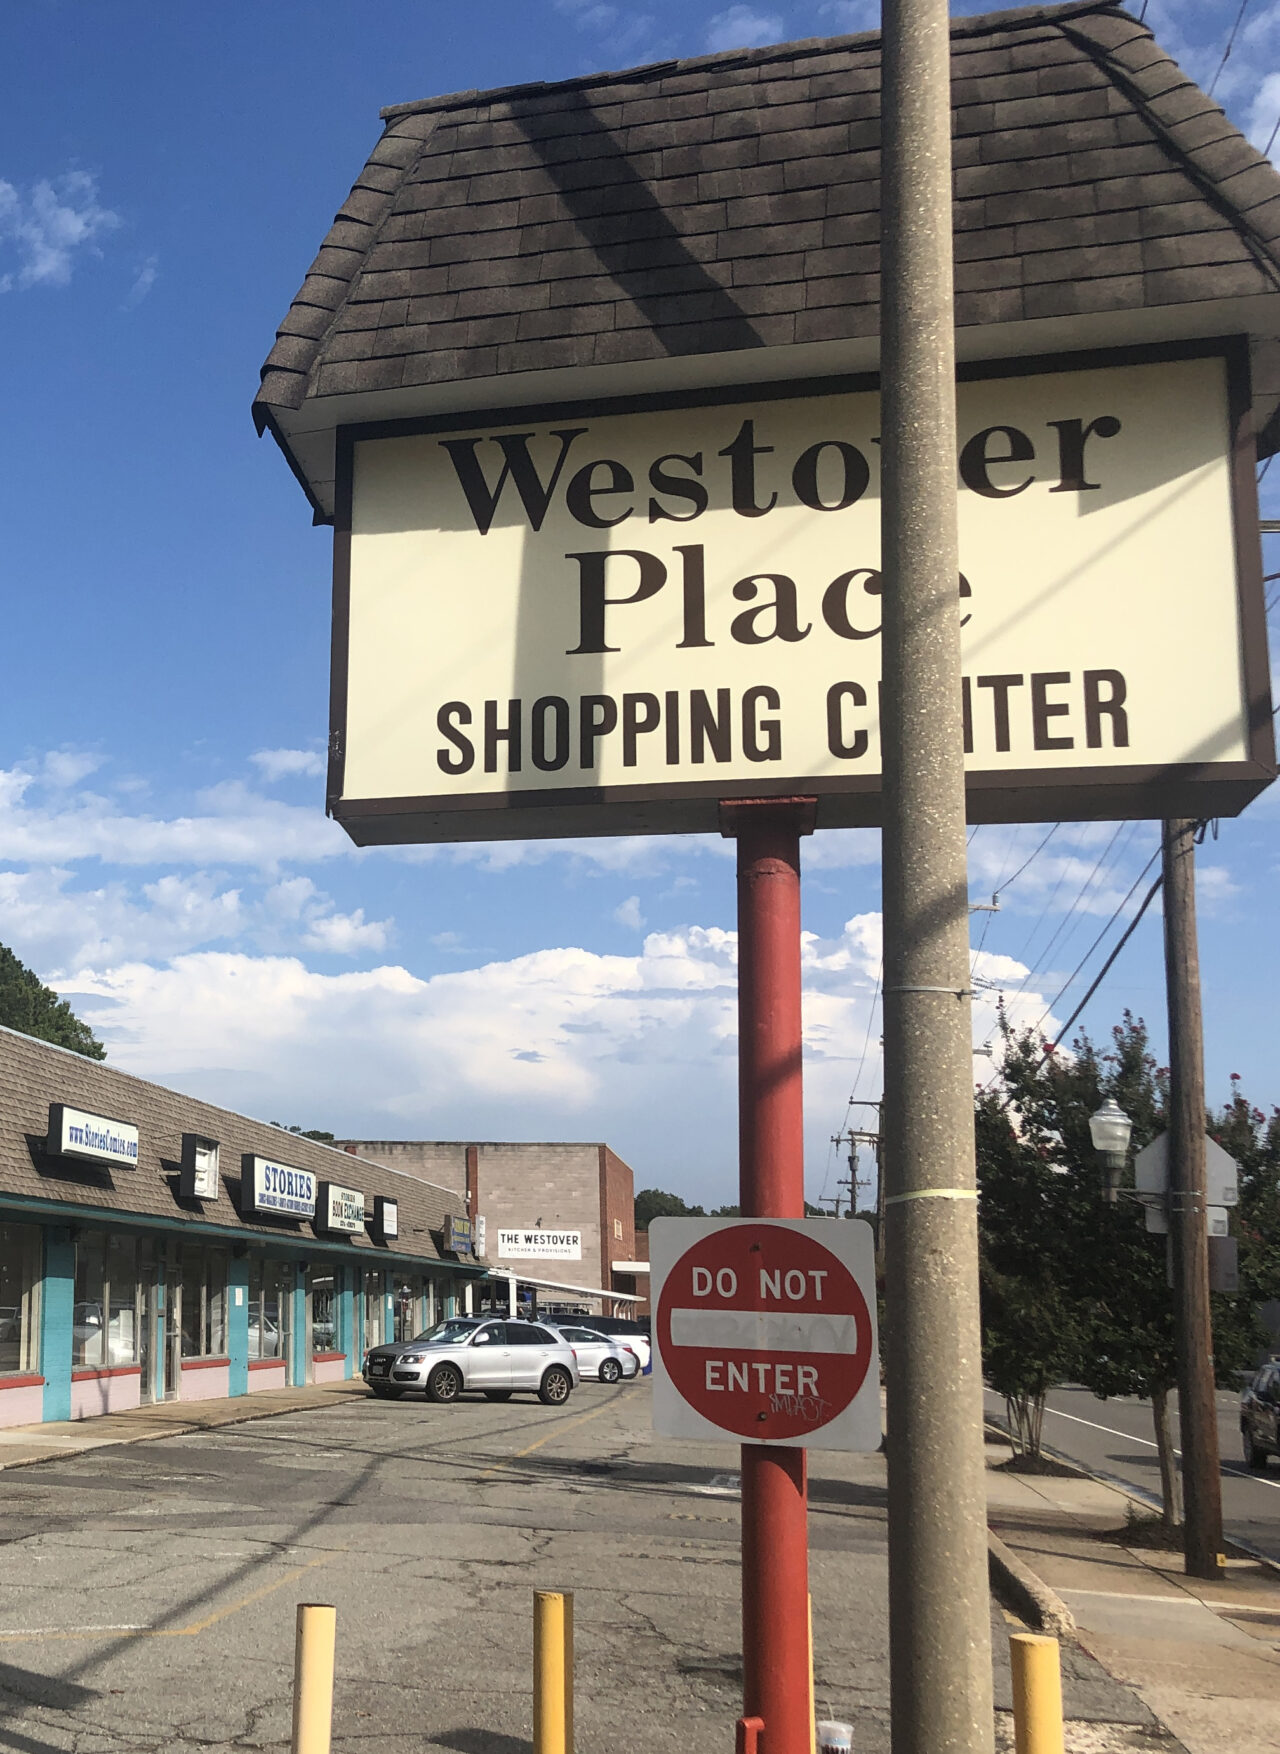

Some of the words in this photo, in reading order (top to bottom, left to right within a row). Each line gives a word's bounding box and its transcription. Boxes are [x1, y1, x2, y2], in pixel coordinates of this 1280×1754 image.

[438, 415, 1122, 535] Westoer
[565, 544, 972, 655] Plac
[436, 685, 782, 776] SHOPPING
[826, 668, 1131, 760] CTER
[264, 1164, 312, 1200] STORIES
[344, 1202, 364, 1222] EXCHANGE
[500, 1233, 519, 1244] THE
[524, 1234, 579, 1245] WESTOVER
[691, 1266, 738, 1298] DO
[759, 1268, 828, 1301] NOT
[704, 1360, 820, 1397] ENTER
